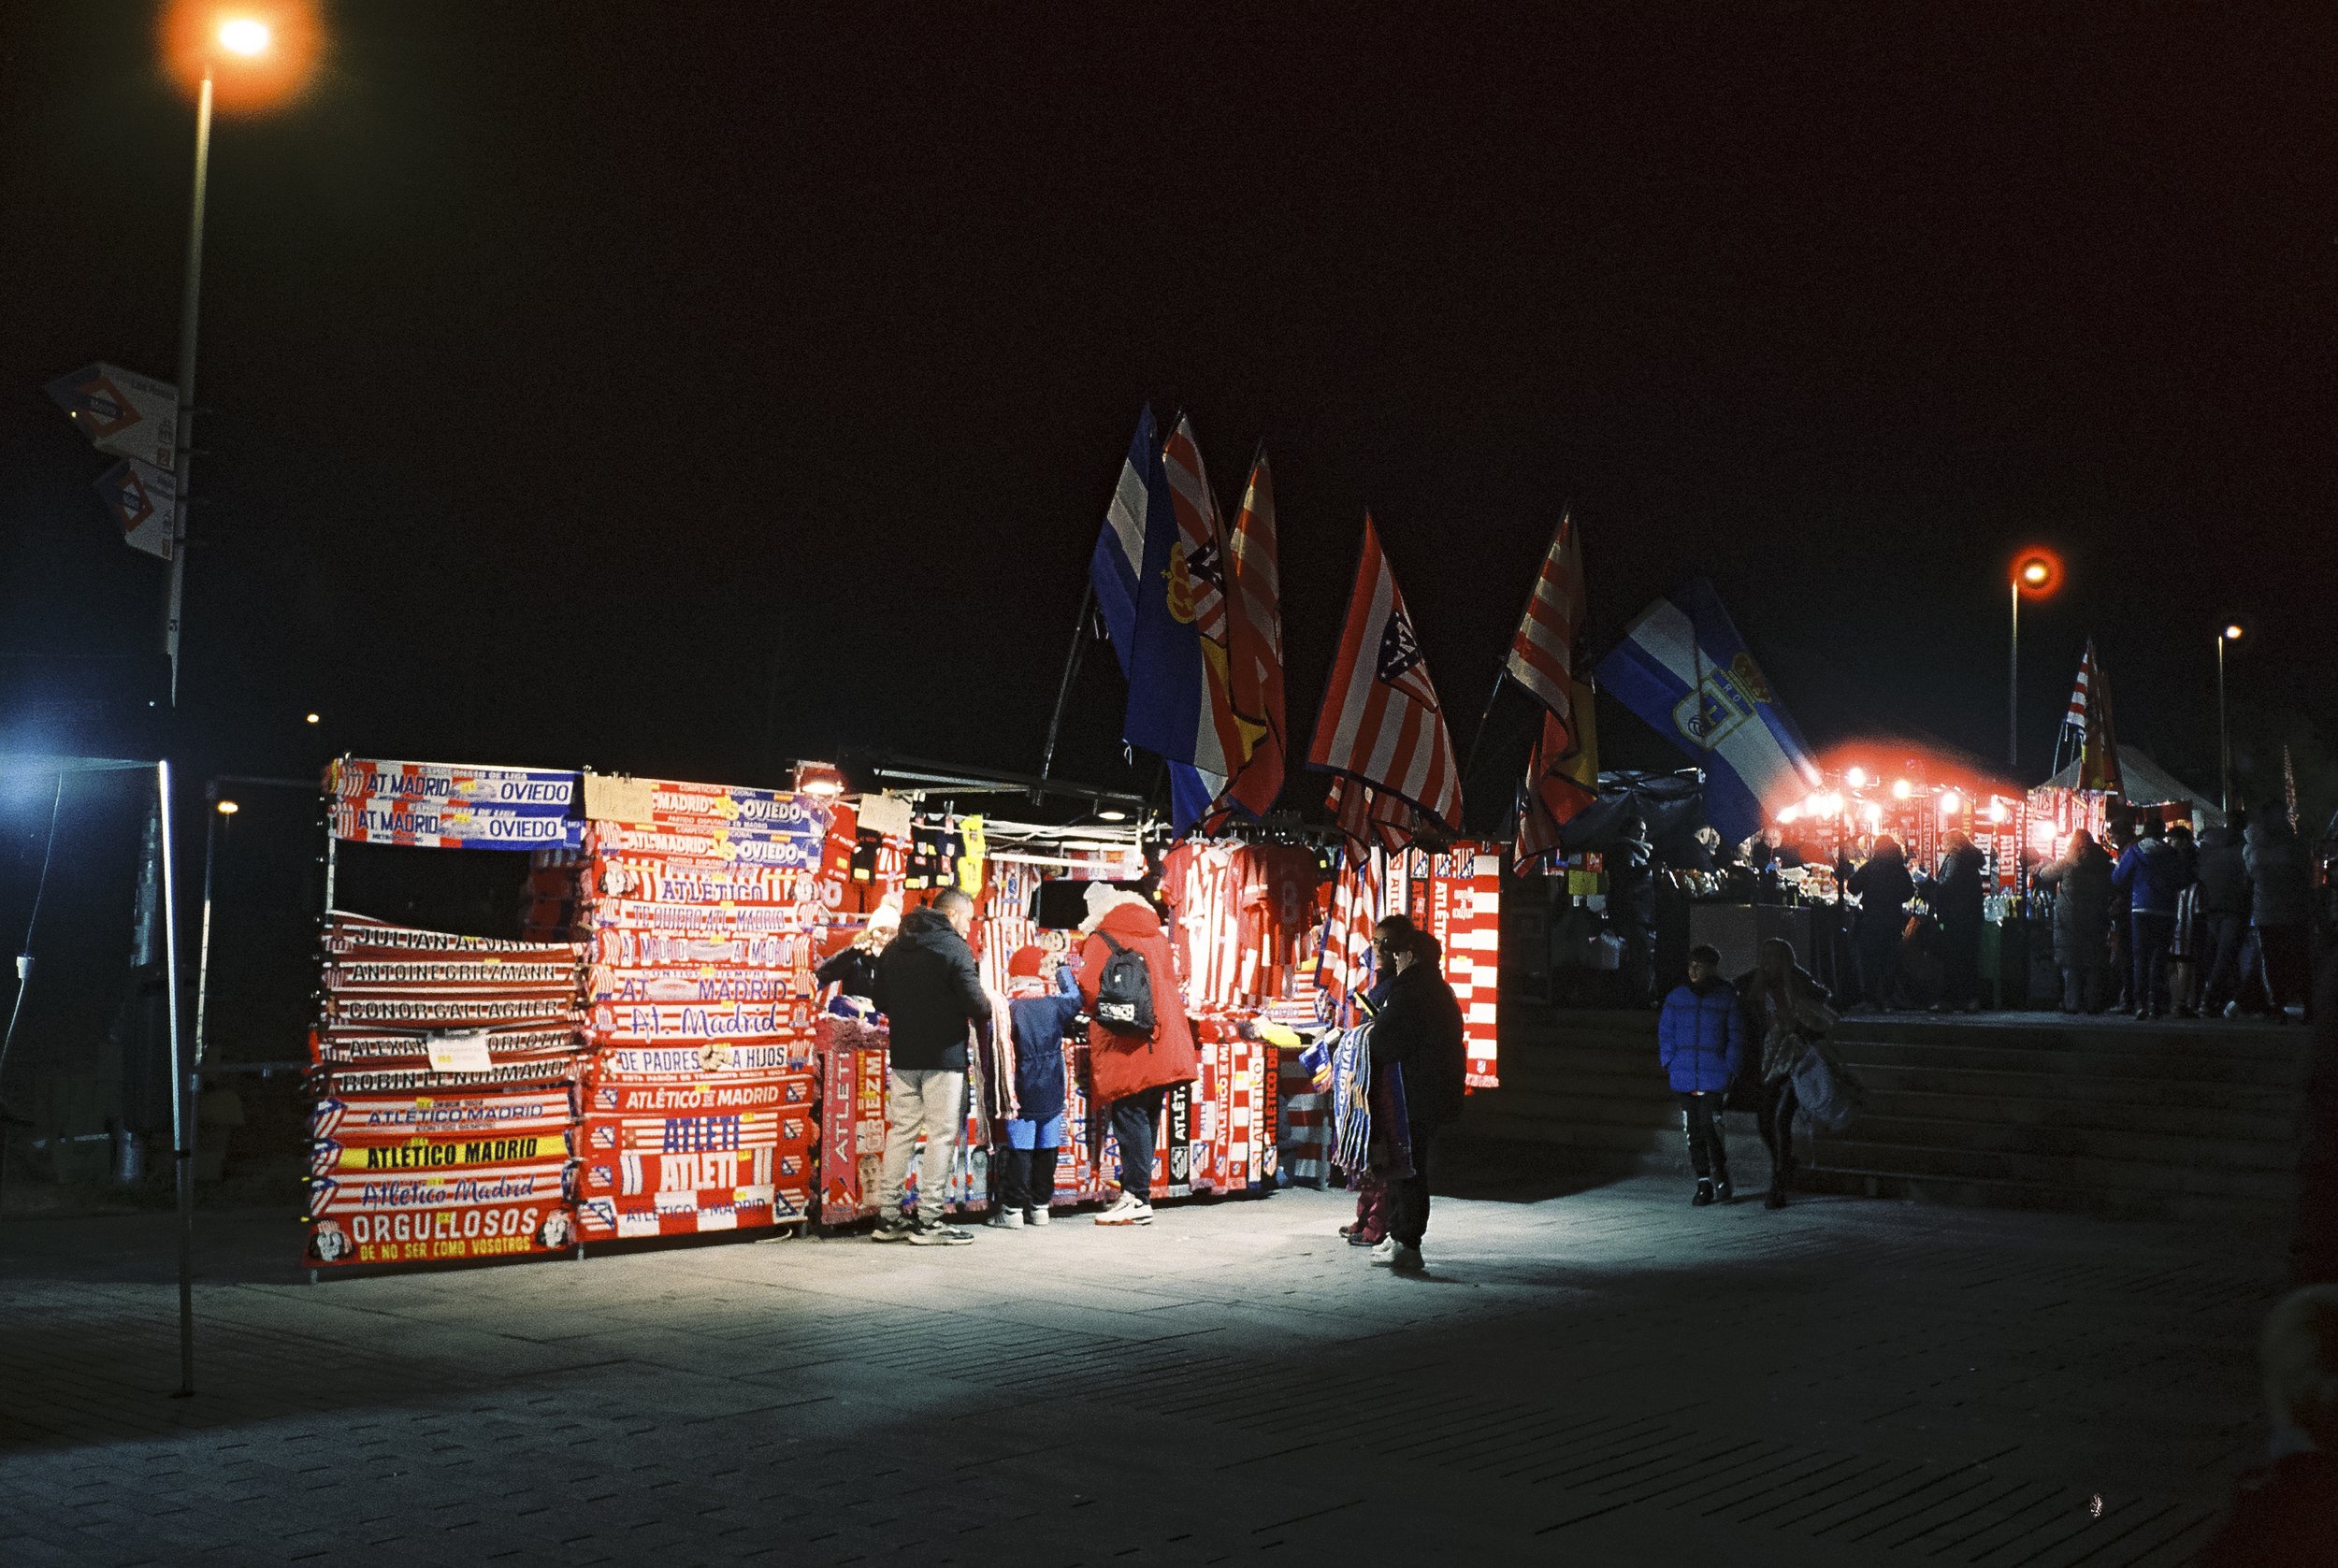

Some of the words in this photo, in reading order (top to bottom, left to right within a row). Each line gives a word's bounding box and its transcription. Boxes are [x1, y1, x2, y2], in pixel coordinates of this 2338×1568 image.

[367, 774, 388, 791] AT
[391, 776, 450, 798] MADRID
[500, 782, 569, 802] OVIEDO
[657, 794, 710, 815] MADRID
[743, 799, 802, 823] OVIEDO
[358, 810, 377, 829] AT
[381, 812, 439, 835] MADRID
[490, 819, 557, 838] OVIEDO
[741, 842, 800, 865] OVIEDO
[1390, 877, 1402, 915] ATLÉ
[633, 905, 650, 927] TE
[654, 906, 702, 929] QUIERO
[706, 908, 727, 930] ATL
[736, 910, 785, 931] MADRID
[354, 928, 450, 950] JULIAN
[642, 938, 685, 961] MADRID
[751, 940, 794, 966] MADRID
[353, 964, 440, 982] ANTOINE
[444, 963, 556, 981] GRIEZMANN
[620, 978, 650, 1001] AT
[699, 979, 787, 1001] MADRID
[348, 1001, 428, 1020] CONOR
[433, 1000, 558, 1020] GALLAGHER
[682, 1002, 778, 1038] Madrid
[350, 1037, 428, 1056] ALEXAN
[619, 1052, 638, 1072] DE
[643, 1050, 701, 1072] PADRES
[732, 1051, 742, 1069] A
[746, 1046, 786, 1068] HIJOS
[342, 1072, 415, 1093] ROBIN
[454, 1060, 563, 1087] NORMAND
[626, 1087, 701, 1109] ATLÉTICO
[716, 1086, 779, 1106] MADRID
[835, 1053, 851, 1164] ATLETI
[865, 1049, 883, 1152] GRIEZM
[367, 1107, 463, 1126] ATLÉTICO
[467, 1104, 543, 1123] MADRID
[663, 1115, 740, 1153] ATLETI
[367, 1141, 456, 1169] ATLÉTICO
[465, 1138, 538, 1161] MADRID
[659, 1151, 738, 1192] ATLETI
[455, 1173, 537, 1201] Madrid
[710, 1197, 766, 1216] MADRID
[353, 1207, 540, 1244] ORGULLOSOS
[360, 1244, 374, 1261] DE
[381, 1243, 398, 1260] NO
[404, 1242, 427, 1259] SER
[433, 1240, 466, 1257] COMO
[471, 1236, 531, 1256] VOSOTROS
